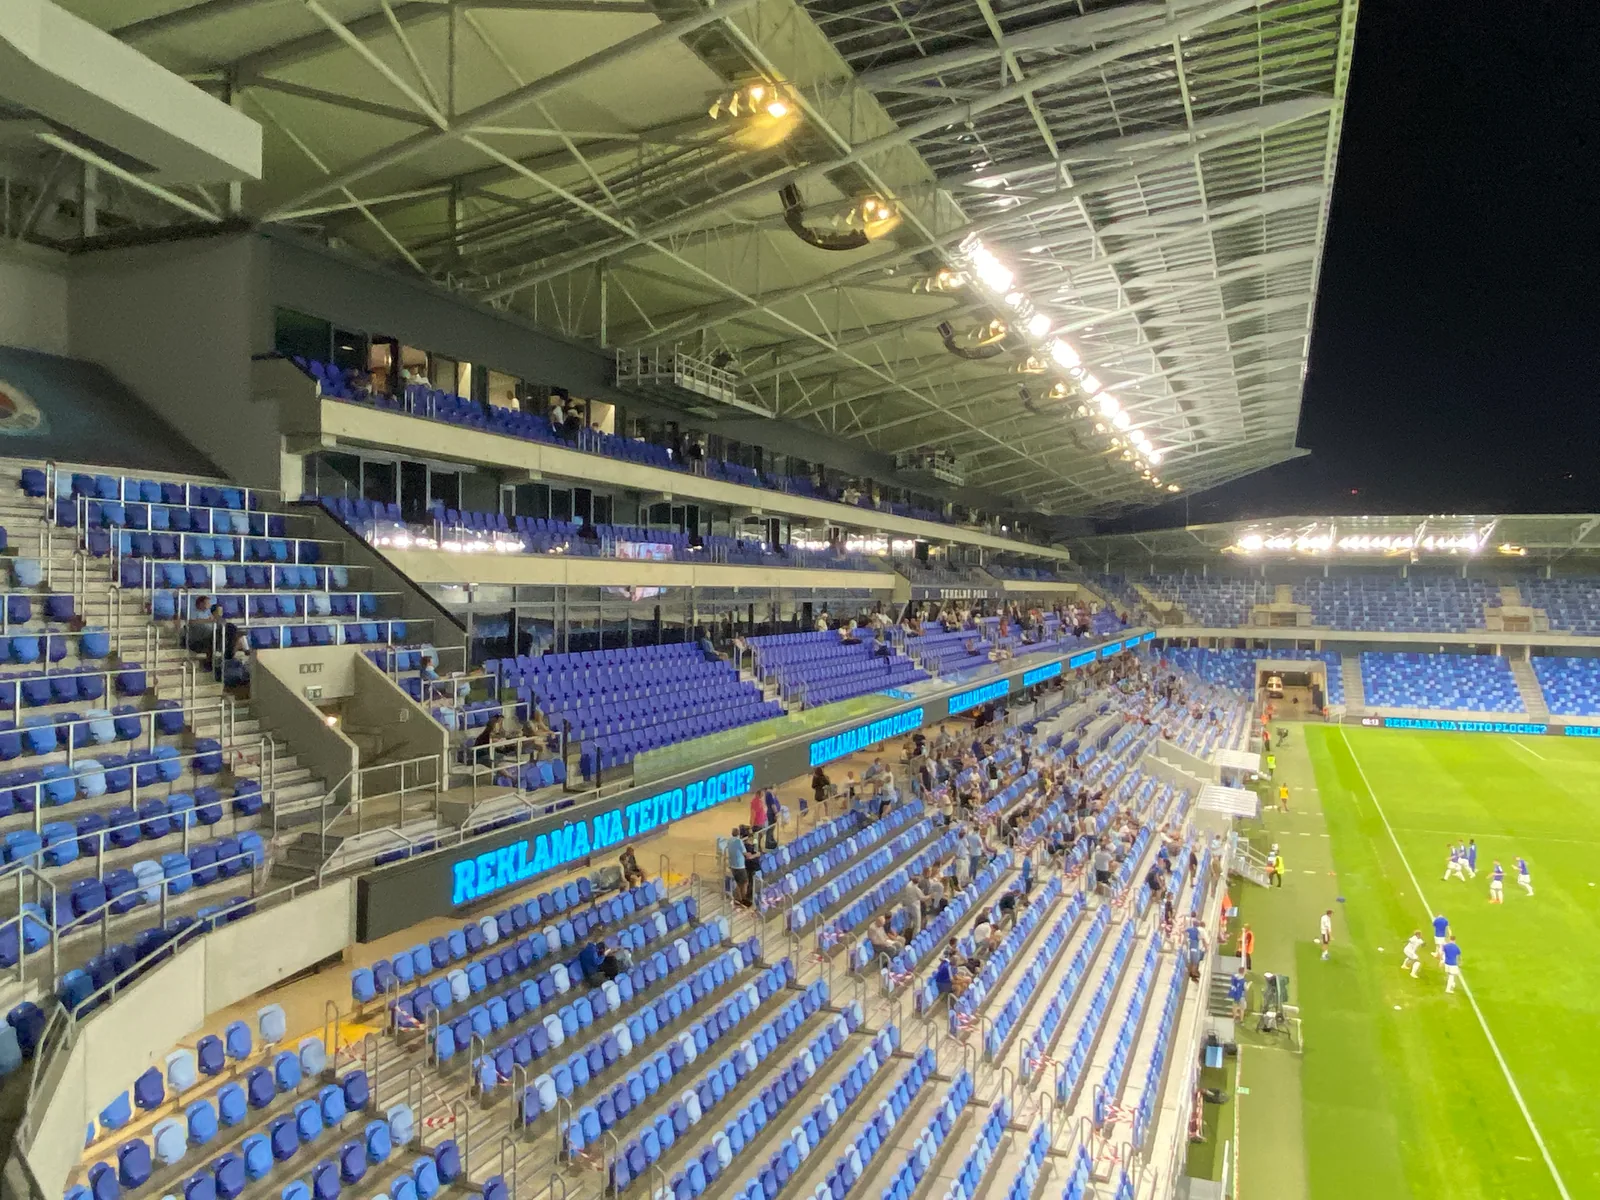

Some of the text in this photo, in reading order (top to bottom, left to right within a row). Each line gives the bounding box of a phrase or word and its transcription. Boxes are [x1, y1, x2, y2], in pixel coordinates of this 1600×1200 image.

[299, 663, 324, 674] EXIT
[810, 730, 856, 766] REKLAMA
[857, 725, 870, 749] NA
[870, 718, 893, 743] TEJTO
[1385, 718, 1548, 734] REKLAMA NA TEJTO PLOCHE?
[453, 763, 755, 905] REKLAMA NA TEJTO PLOCHE?
